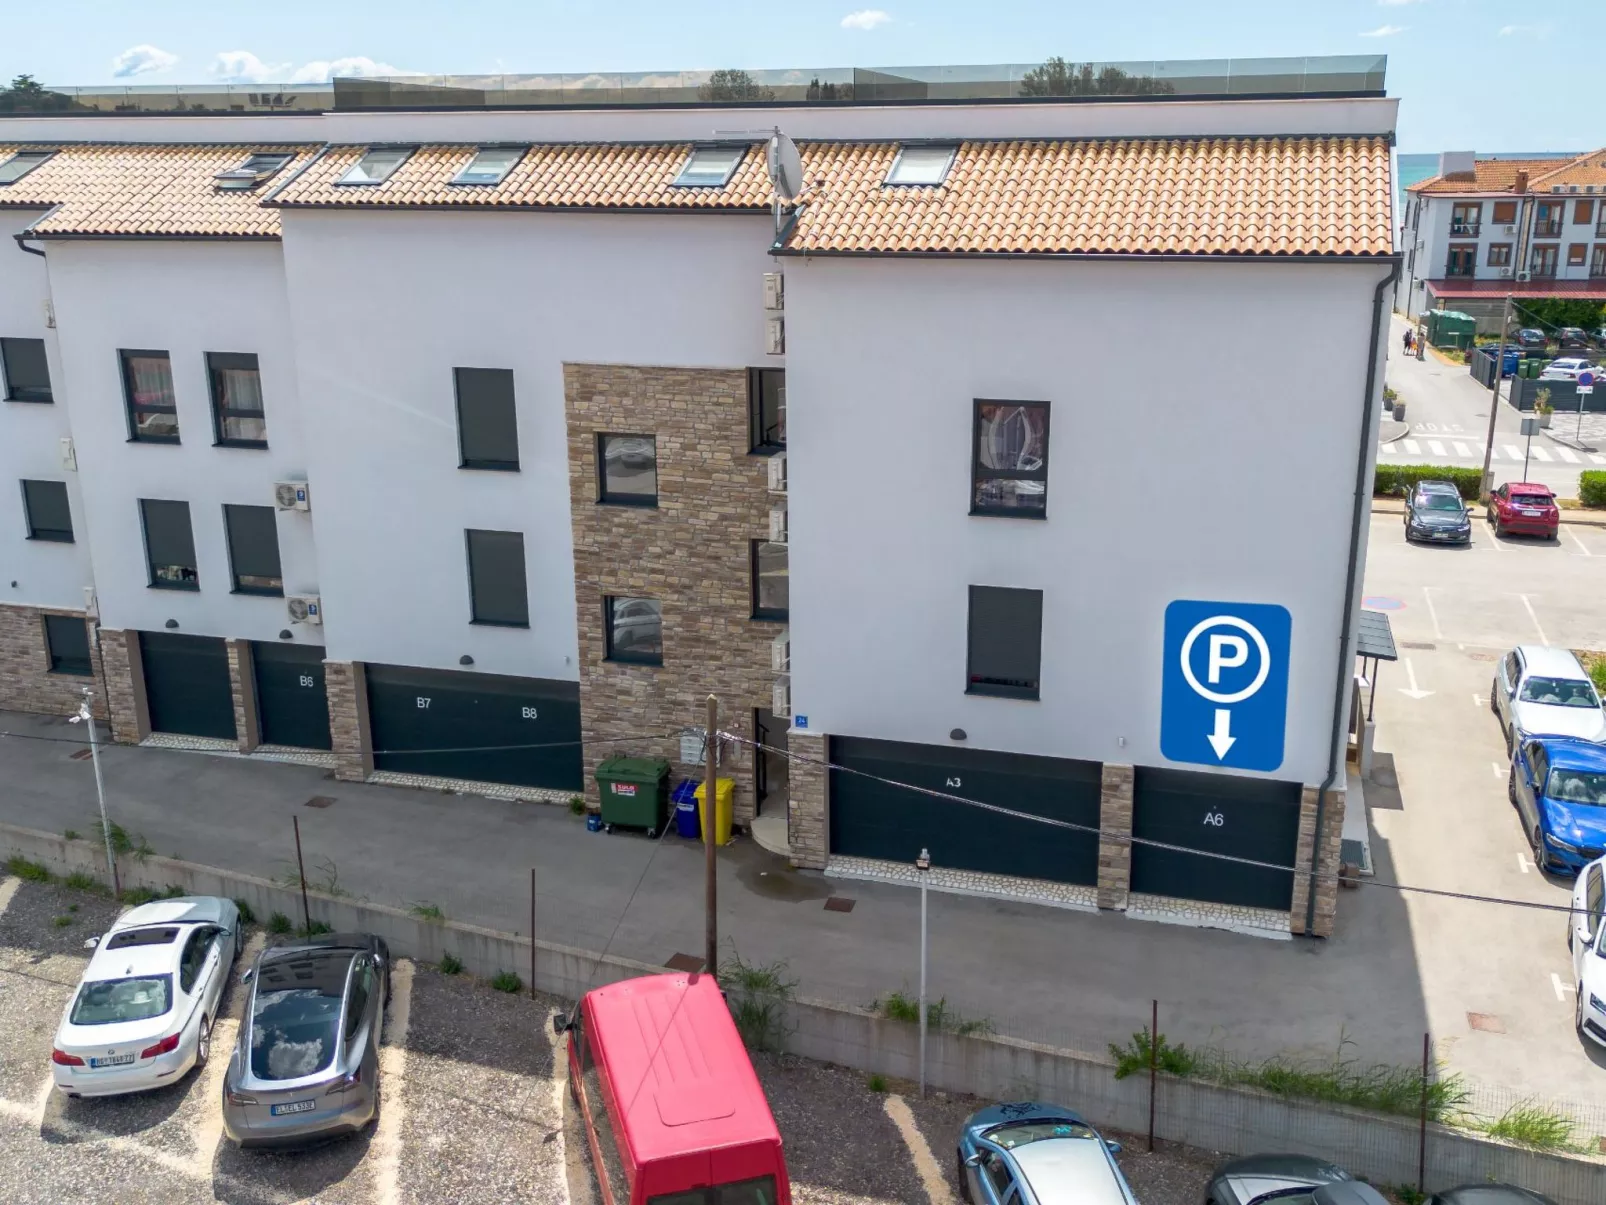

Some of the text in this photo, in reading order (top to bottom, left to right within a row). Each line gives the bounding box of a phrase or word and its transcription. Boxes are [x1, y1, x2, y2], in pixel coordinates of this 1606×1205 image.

[1208, 634, 1249, 684] P
[300, 675, 314, 687] B6
[416, 696, 431, 708] B7
[522, 706, 537, 719] B8
[946, 777, 961, 788] A3
[1203, 812, 1224, 826] A6
